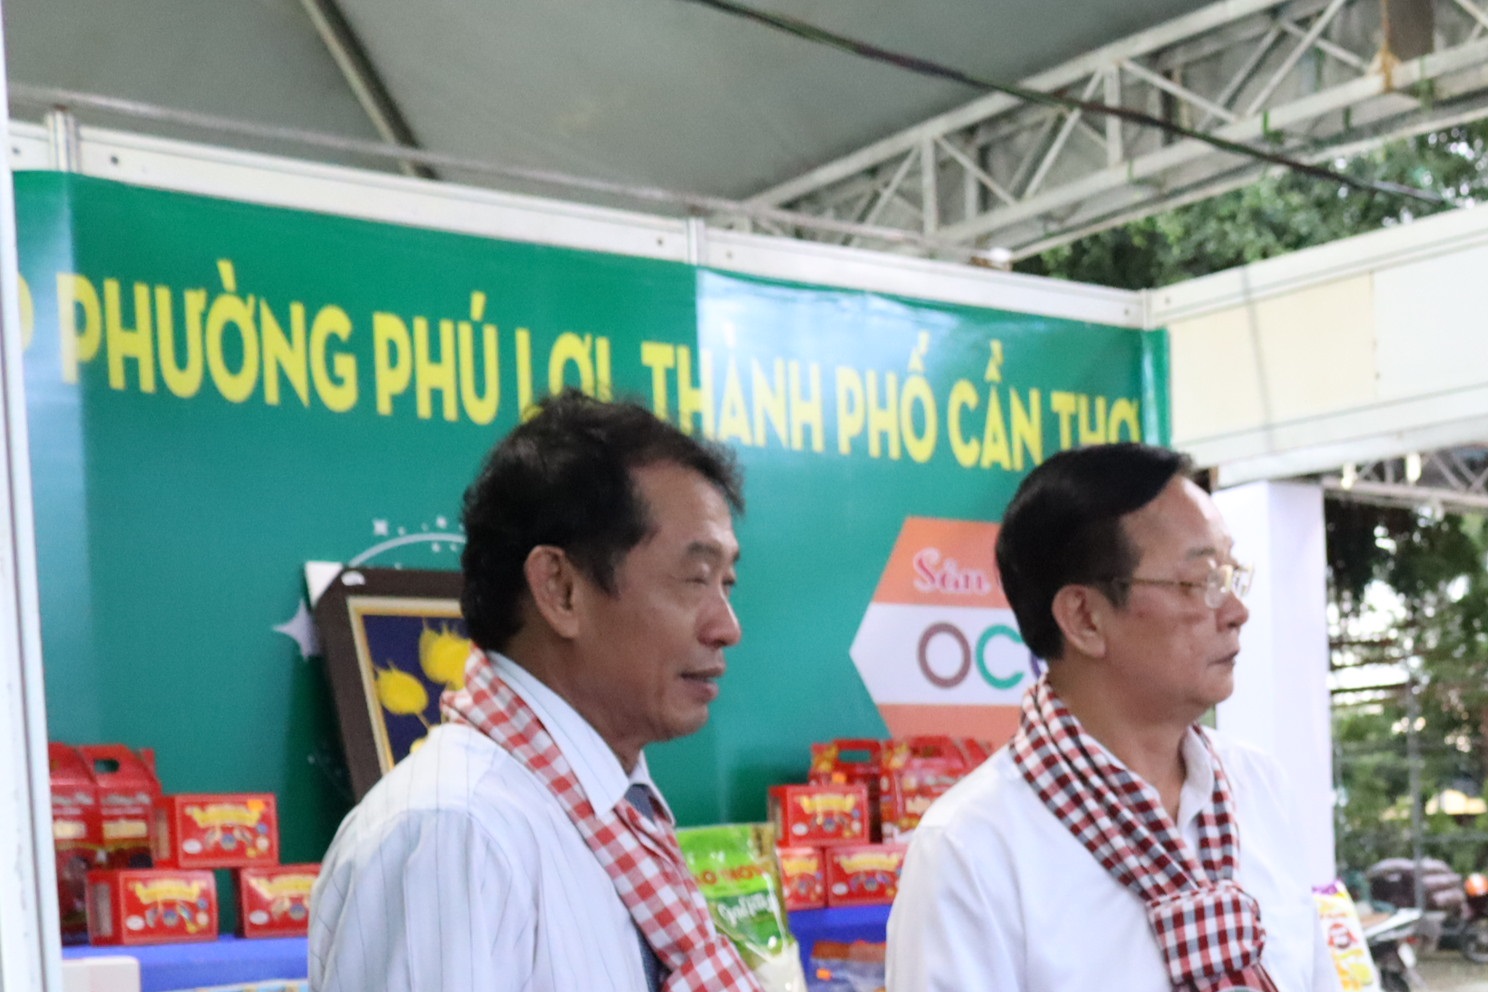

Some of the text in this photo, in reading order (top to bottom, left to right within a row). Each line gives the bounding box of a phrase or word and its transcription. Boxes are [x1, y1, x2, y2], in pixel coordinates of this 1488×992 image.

[56, 258, 358, 414] PHƯỜNG
[373, 291, 500, 425] PHÚ
[641, 320, 824, 453] THÀNH
[837, 331, 938, 464] PHỐ
[918, 621, 1043, 689] OC
